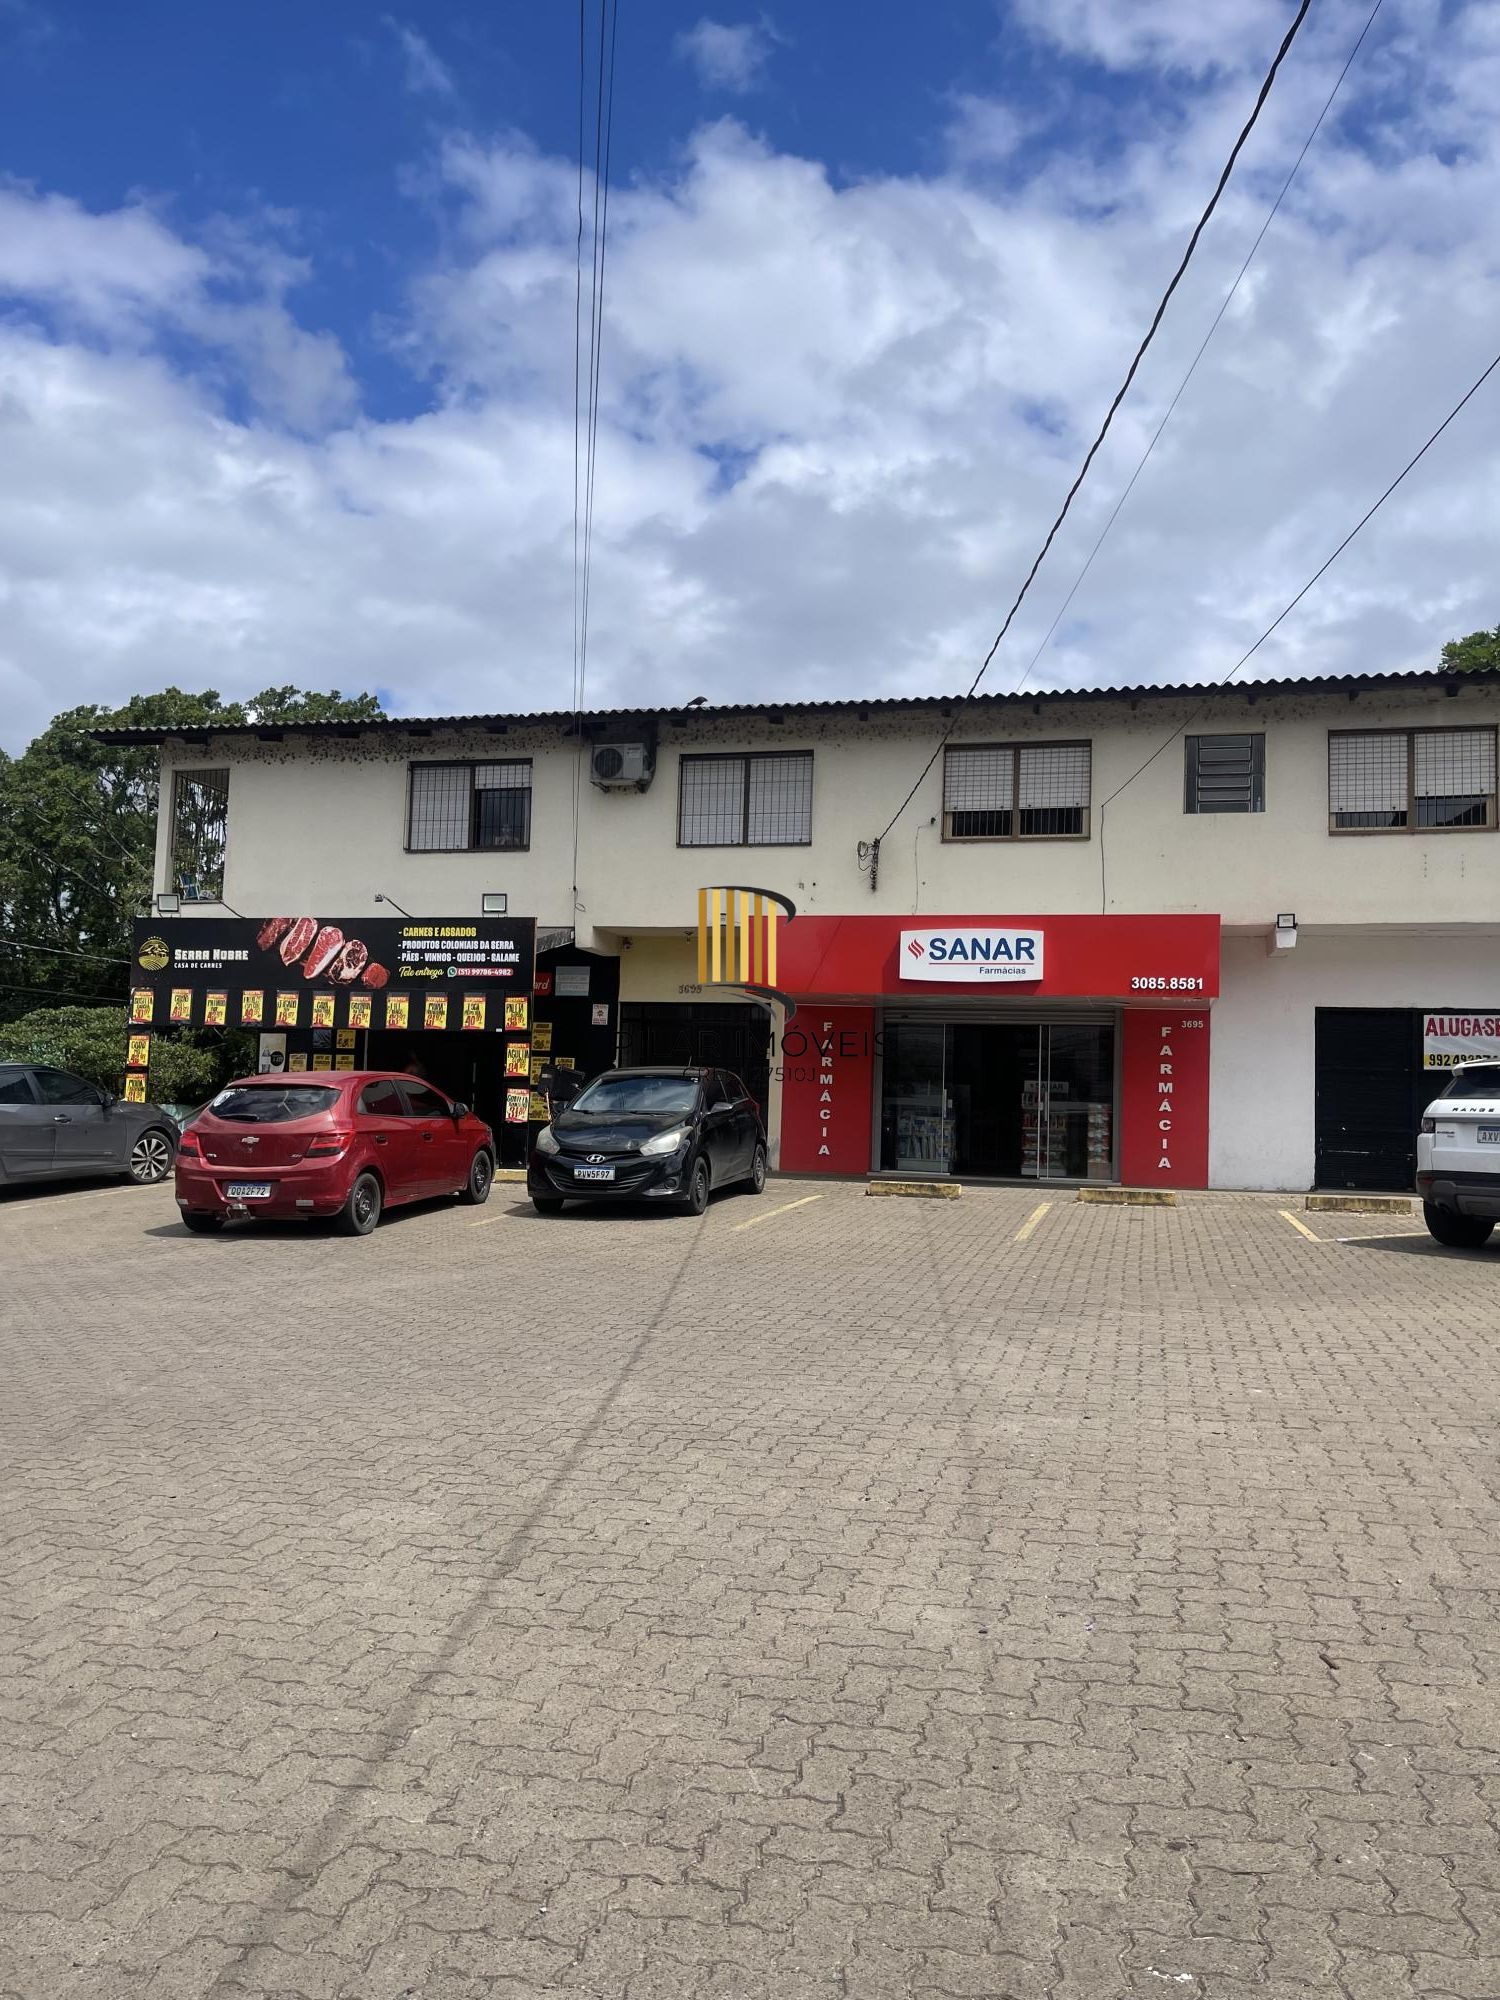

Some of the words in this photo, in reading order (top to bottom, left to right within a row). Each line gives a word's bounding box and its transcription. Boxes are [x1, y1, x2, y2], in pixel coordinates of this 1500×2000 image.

[403, 927, 433, 937] CARNES
[434, 927, 440, 937] E
[440, 927, 477, 937] ASSADOS
[402, 940, 440, 950] PRODUTOS
[441, 940, 479, 950] COLONIAIS
[480, 940, 490, 950] DA
[490, 940, 514, 950] SERRA
[928, 937, 1035, 961] SANAR
[174, 948, 210, 961] SERRA
[212, 948, 249, 961] NOBRE
[401, 951, 420, 962] PÃES
[456, 952, 486, 963] QUEIJOS
[491, 952, 520, 963] SALAME
[979, 965, 1026, 975] Farmácias
[1131, 977, 1204, 990] 3085.8581
[1181, 1020, 1204, 1028] 3695
[818, 1021, 834, 1157] FARMÁCIA
[1157, 1026, 1173, 1170] FARMÁCIA
[1481, 1131, 1500, 1142] AXV
